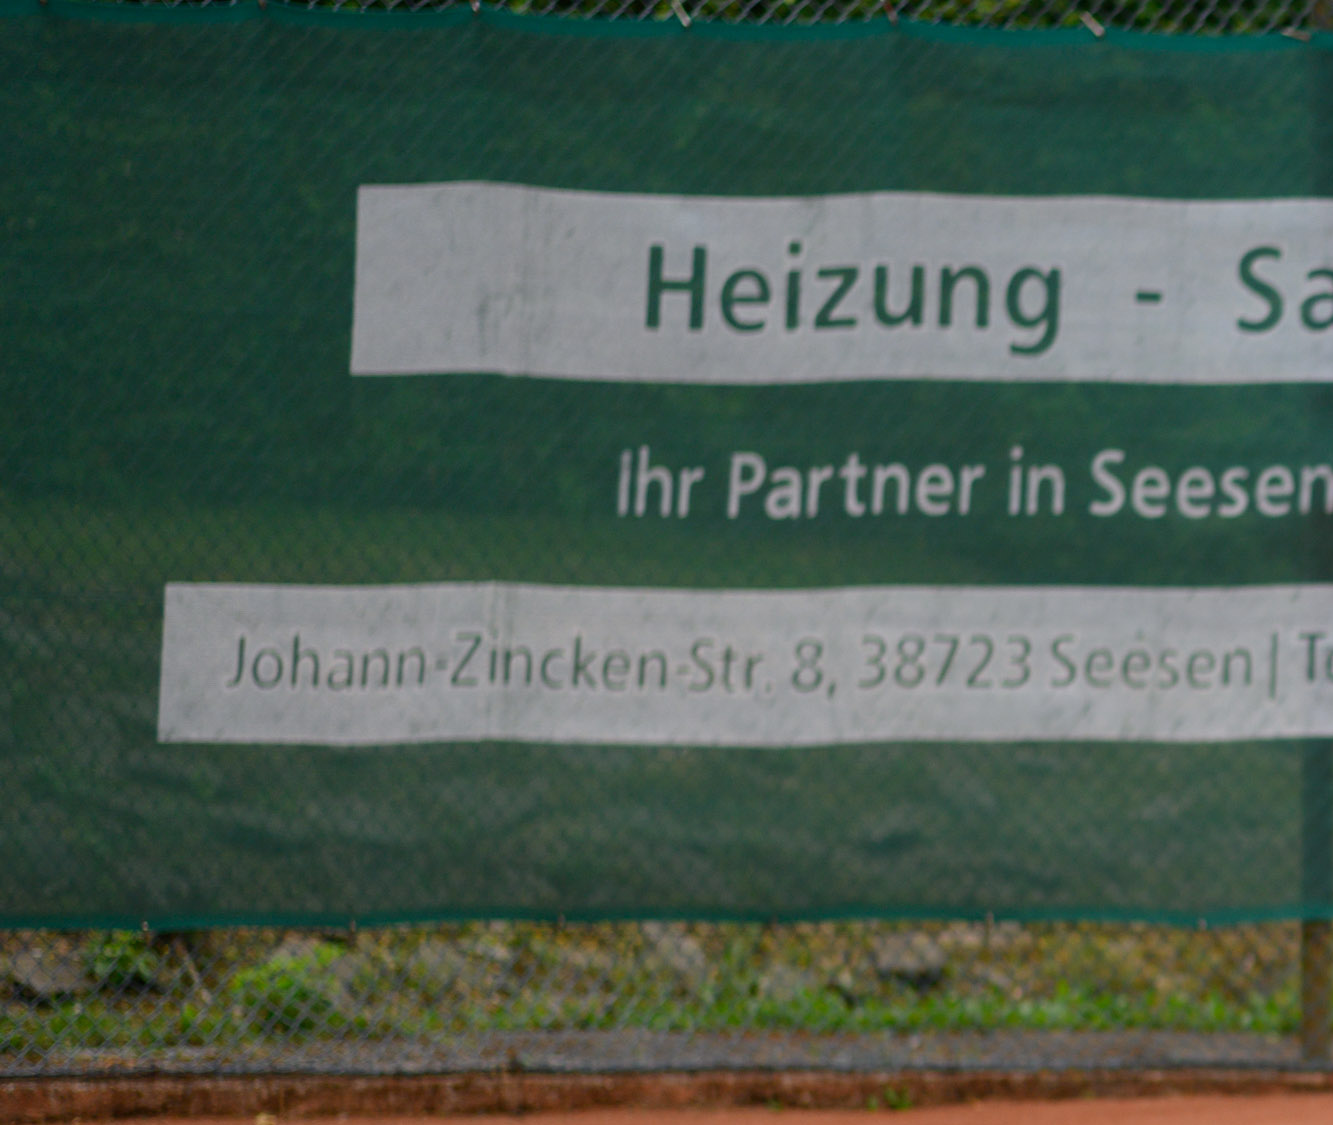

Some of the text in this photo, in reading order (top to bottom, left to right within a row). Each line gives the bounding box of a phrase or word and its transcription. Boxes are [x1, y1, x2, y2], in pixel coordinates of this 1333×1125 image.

[643, 239, 1062, 357] Heizung
[616, 445, 704, 518] Ihr
[726, 451, 986, 520] Partner
[1007, 445, 1066, 516] in
[226, 628, 772, 692] Johann-Zincken-Str.
[790, 637, 837, 699] 8,
[858, 633, 1033, 690] 38723
[1050, 633, 1256, 690] Seesen
